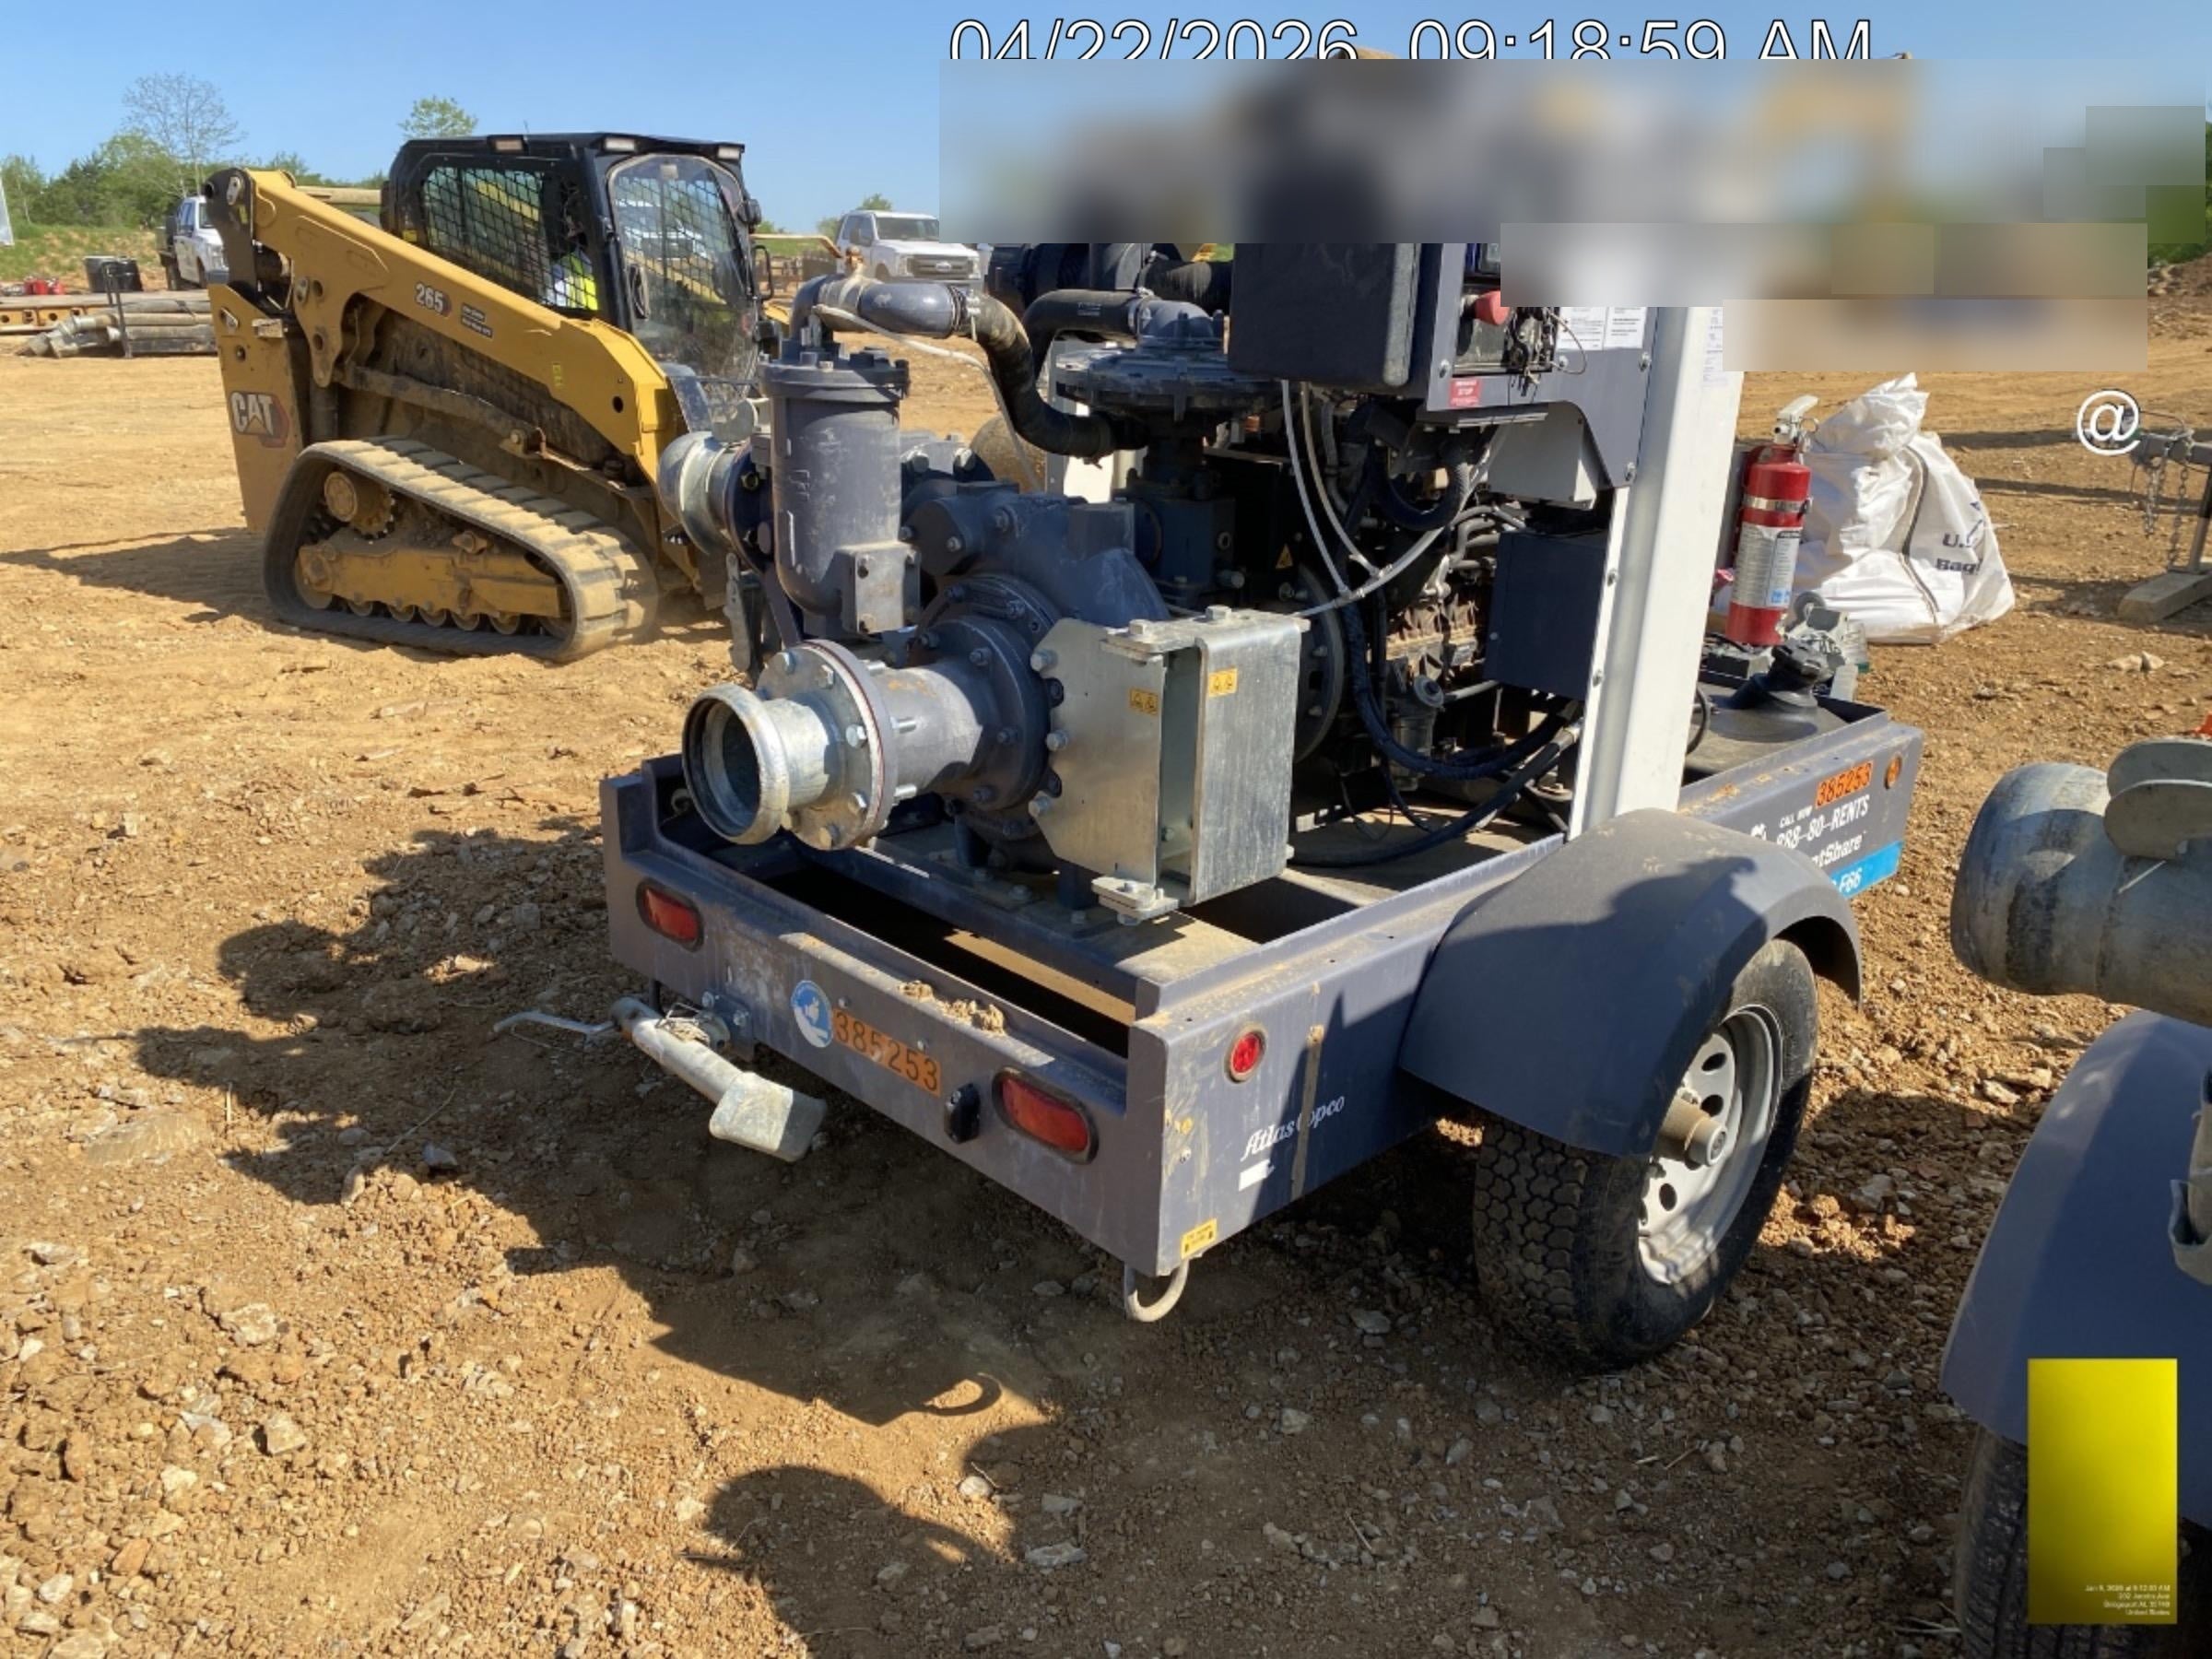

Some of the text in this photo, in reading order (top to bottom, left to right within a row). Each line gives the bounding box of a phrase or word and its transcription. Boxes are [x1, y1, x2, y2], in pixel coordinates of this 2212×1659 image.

[416, 282, 443, 312] 265
[230, 392, 274, 436] CAT
[1817, 761, 1873, 807] 385253
[835, 1012, 938, 1091] 385253
[1241, 1121, 1295, 1162] Atlas
